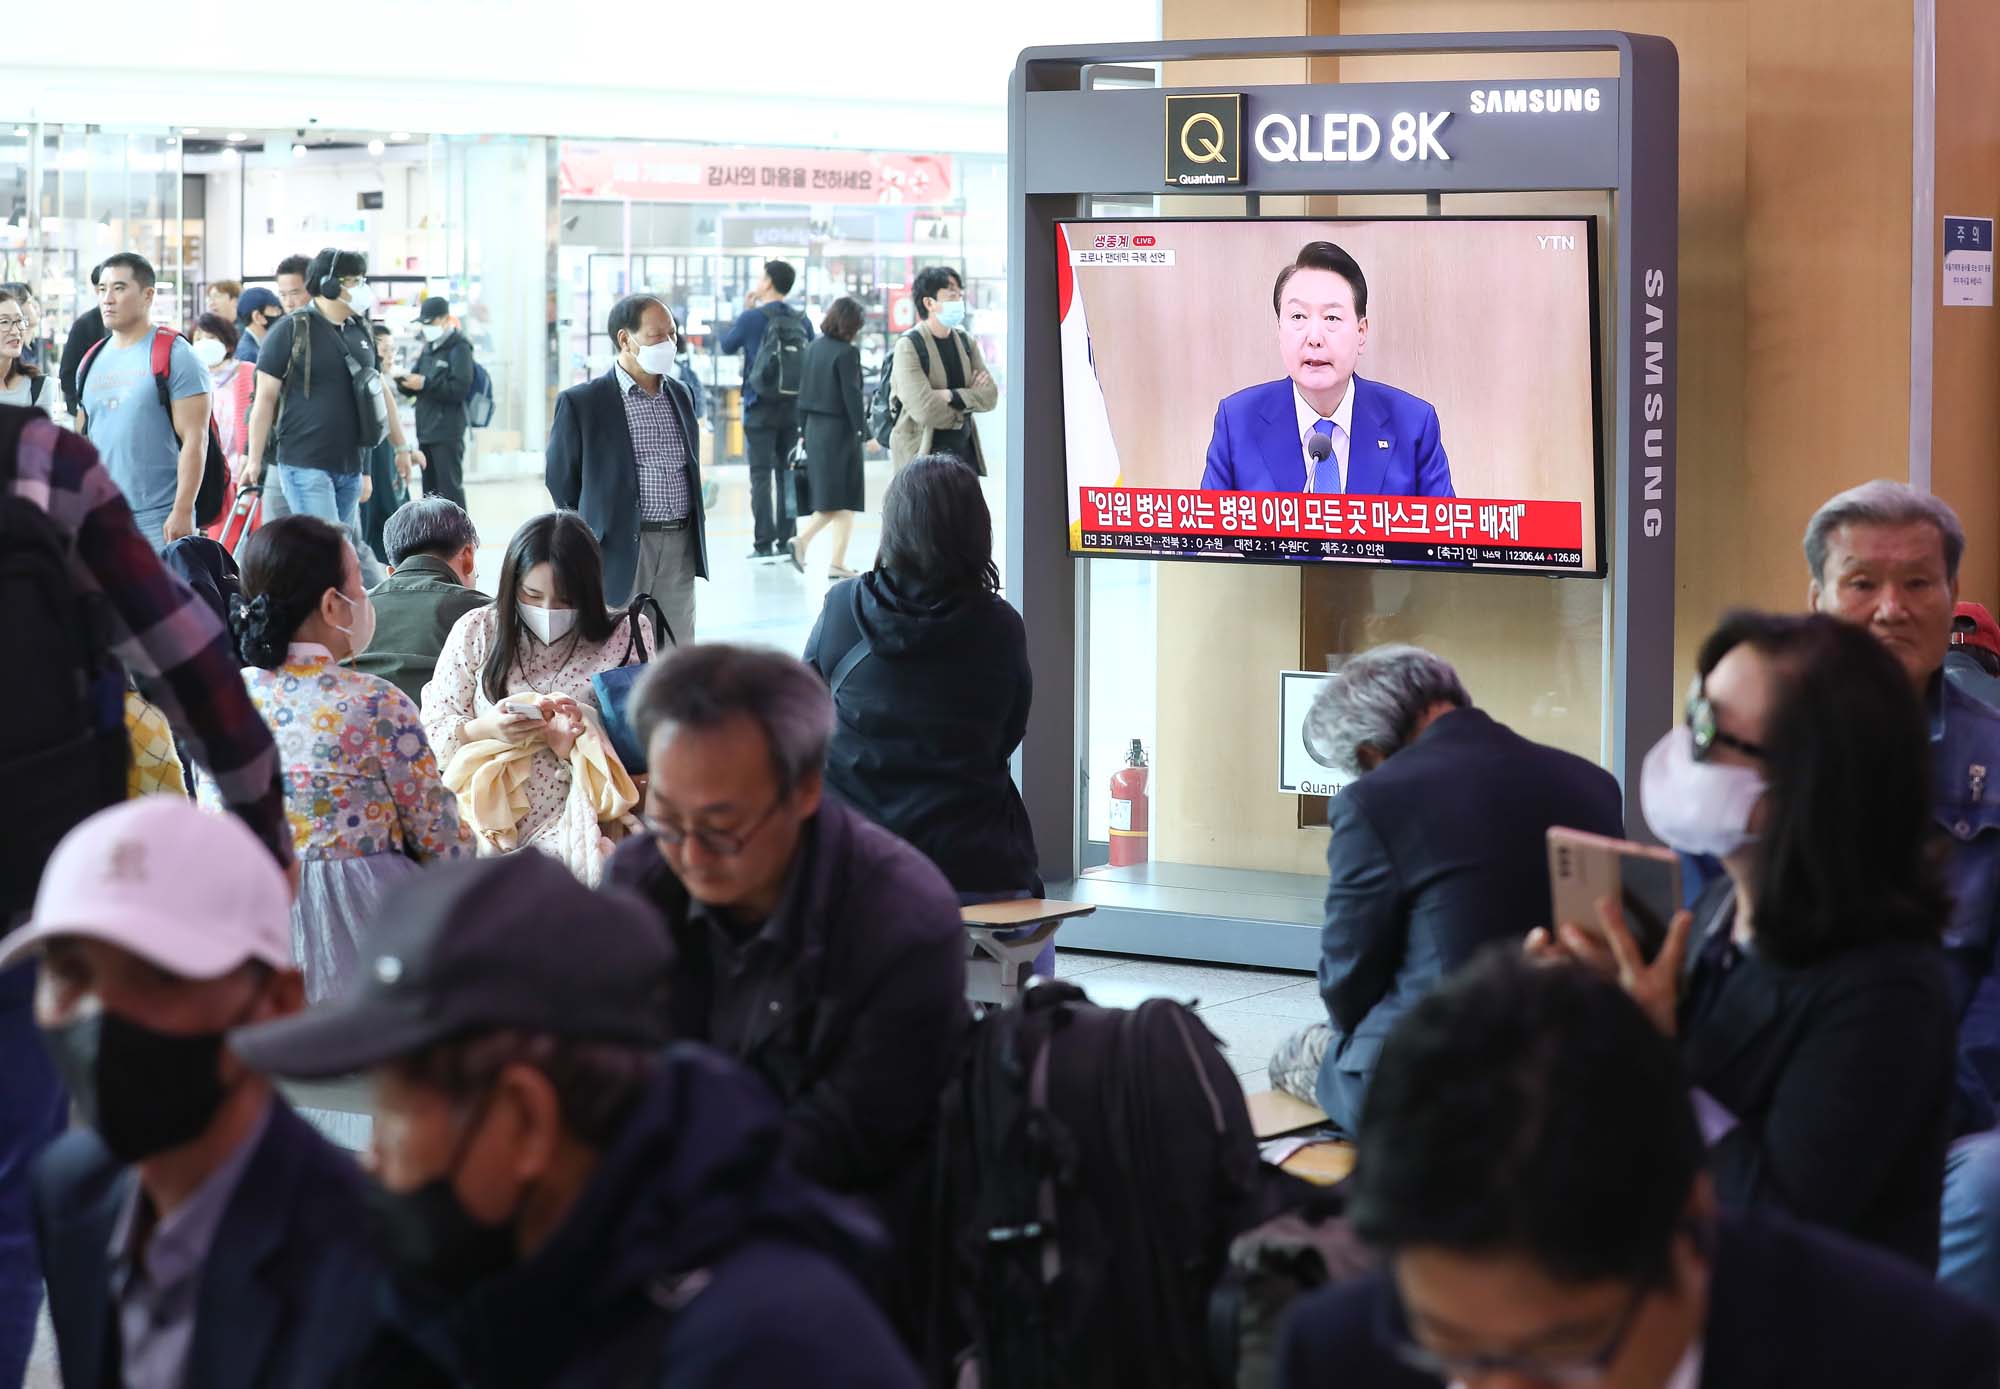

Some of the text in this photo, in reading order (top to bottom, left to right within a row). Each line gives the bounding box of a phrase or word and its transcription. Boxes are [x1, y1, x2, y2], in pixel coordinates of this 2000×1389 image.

[1470, 88, 1600, 113] SAMSUNG
[1180, 112, 1227, 164] Q
[1254, 111, 1451, 162] QLED 8K
[708, 166, 755, 187] 감사의
[761, 167, 806, 189] 마음을
[812, 169, 872, 191] 전하세요
[1179, 173, 1225, 185] Quantum
[1094, 235, 1129, 248] 생중계
[1136, 237, 1153, 245] LIVE
[1536, 235, 1575, 250] YTN
[1080, 252, 1166, 263] 코로나 팬데믹 극복 선언
[1643, 269, 1664, 537] SAMSUNG
[1088, 490, 1525, 541] "입원 병실 있는 병원 이외 모든 곳 마스크 의무 배제"
[1204, 538, 1223, 550] 수원
[1234, 540, 1253, 552] 대전
[1278, 541, 1309, 553] 수원FC
[1320, 542, 1340, 555] 제주
[1365, 544, 1384, 557] 인천
[1437, 546, 1464, 561] [축구]
[1482, 550, 1581, 563] 나스닥 12306.44 126.89
[1301, 780, 1344, 795] Quant
